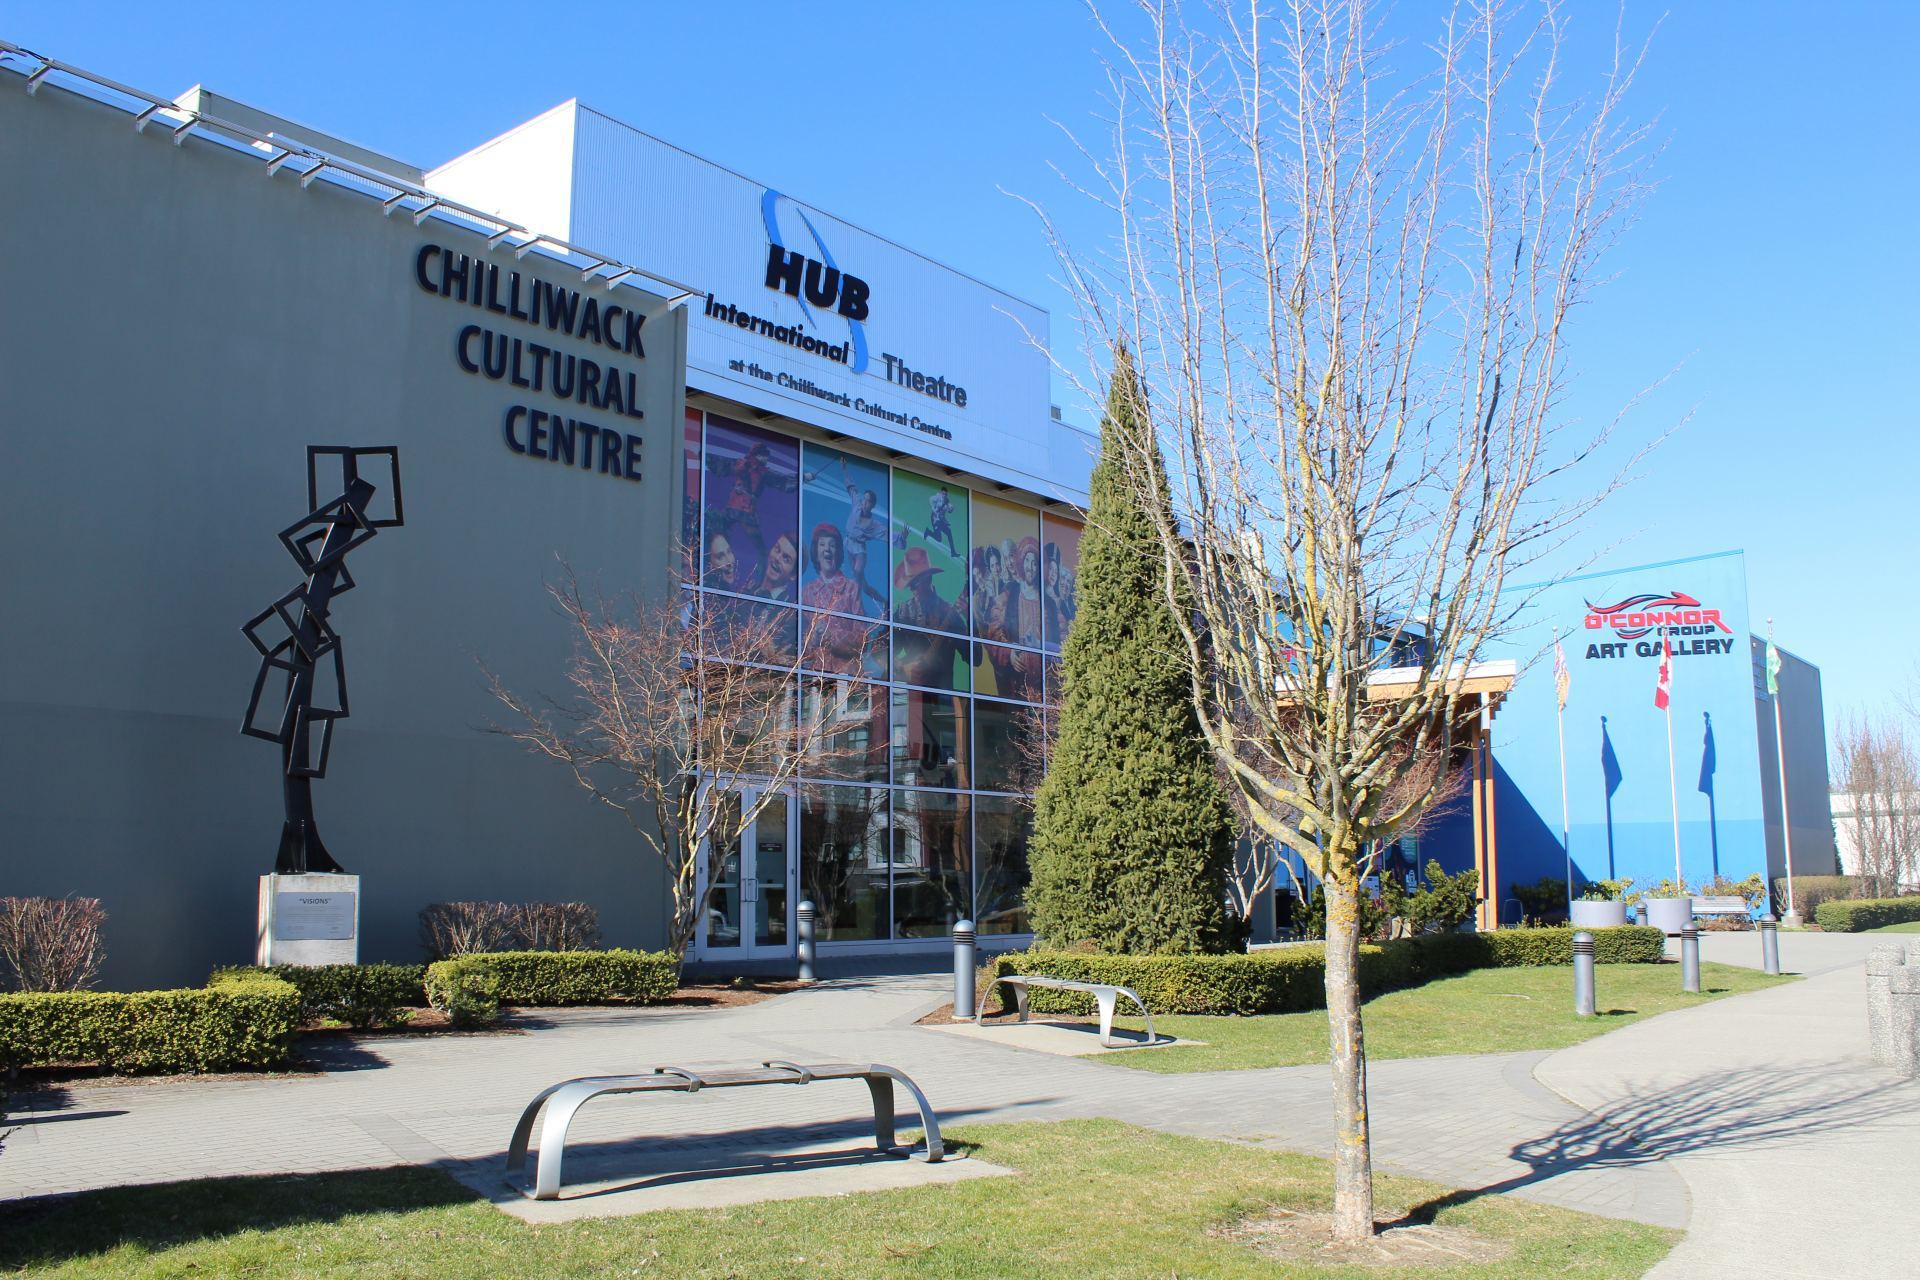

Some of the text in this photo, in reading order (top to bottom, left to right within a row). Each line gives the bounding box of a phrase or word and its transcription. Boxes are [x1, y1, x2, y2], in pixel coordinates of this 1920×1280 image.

[416, 244, 647, 358] CHILLIWACK
[765, 242, 870, 321] HUB
[457, 325, 644, 419] CULTURAL
[705, 293, 967, 408] International Theatre
[729, 359, 952, 440] at the Chilliwack Cultural Centre
[503, 405, 642, 481] CENTRE
[1585, 610, 1733, 633] O'CONNOR
[1585, 643, 1627, 659] ART
